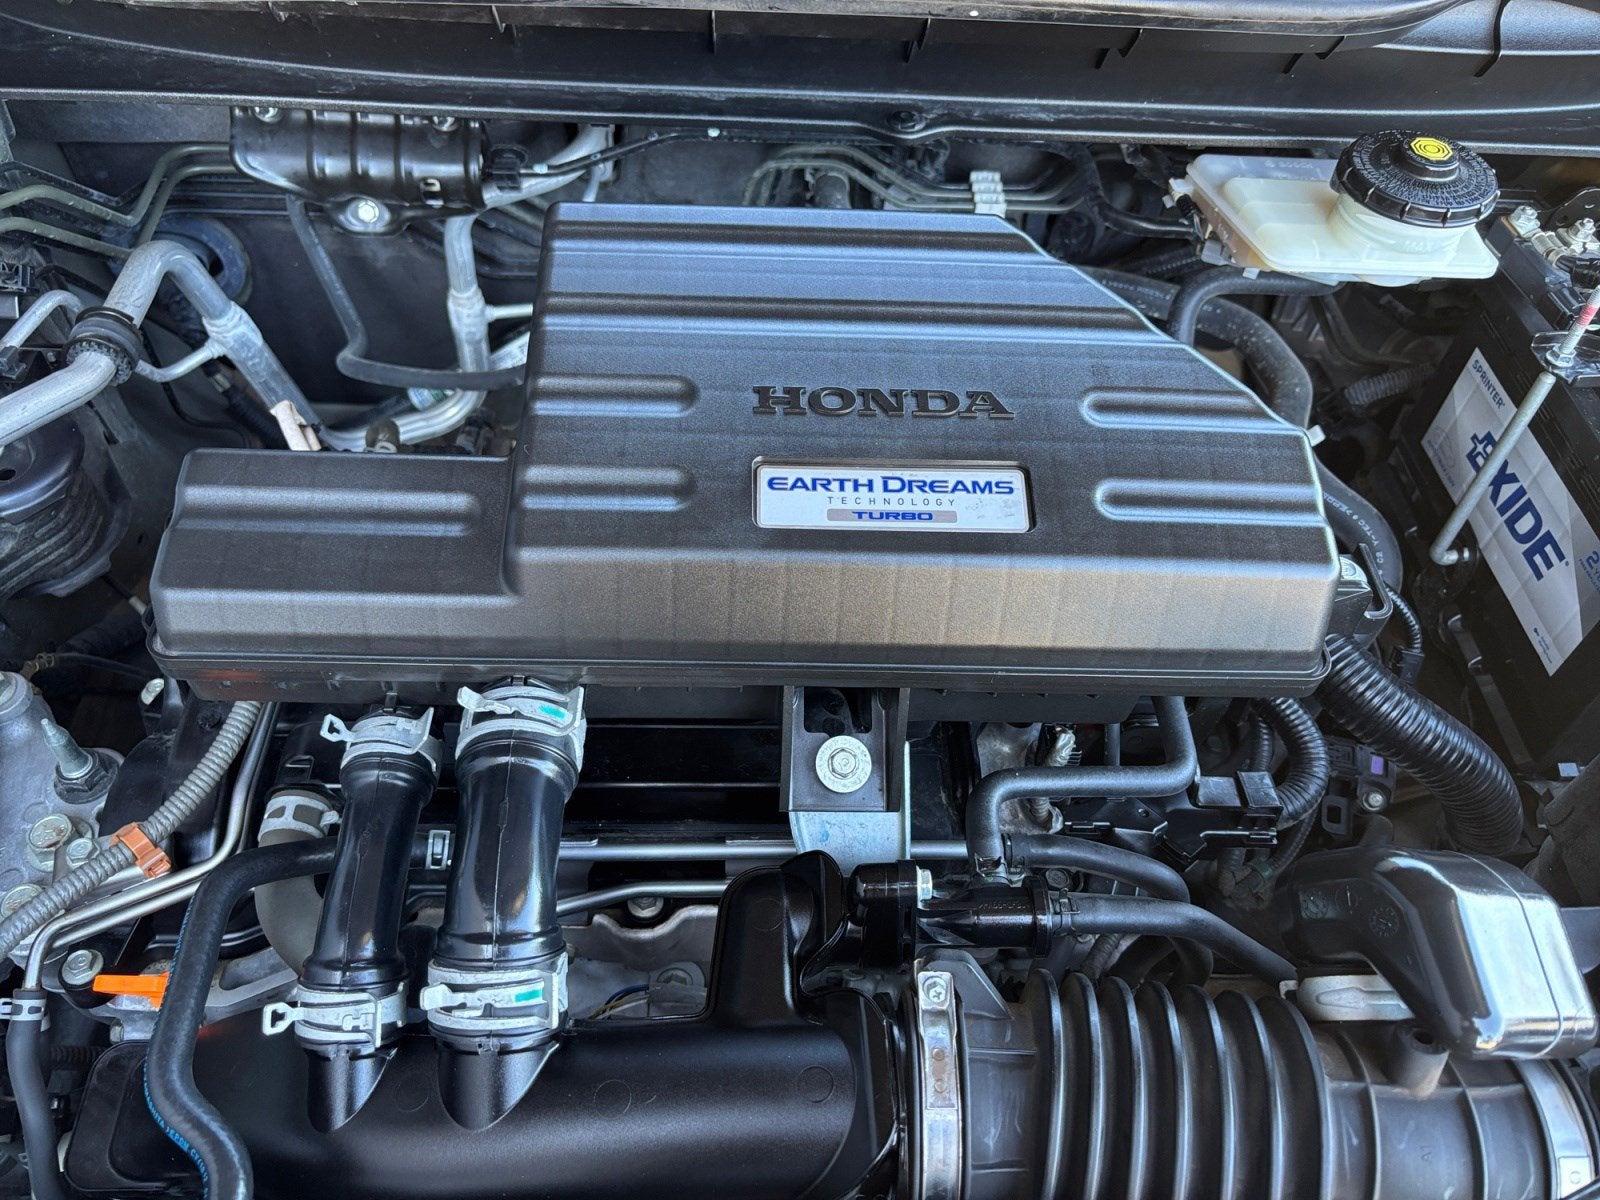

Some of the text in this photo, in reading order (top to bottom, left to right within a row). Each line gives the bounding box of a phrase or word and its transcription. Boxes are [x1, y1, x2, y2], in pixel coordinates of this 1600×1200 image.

[1472, 359, 1503, 409] SPRINTER
[752, 385, 1015, 420] HONDA
[767, 475, 1015, 495] EARTH DREAMS
[827, 496, 955, 507] TECHNOLOGY
[851, 510, 934, 521] TURBO
